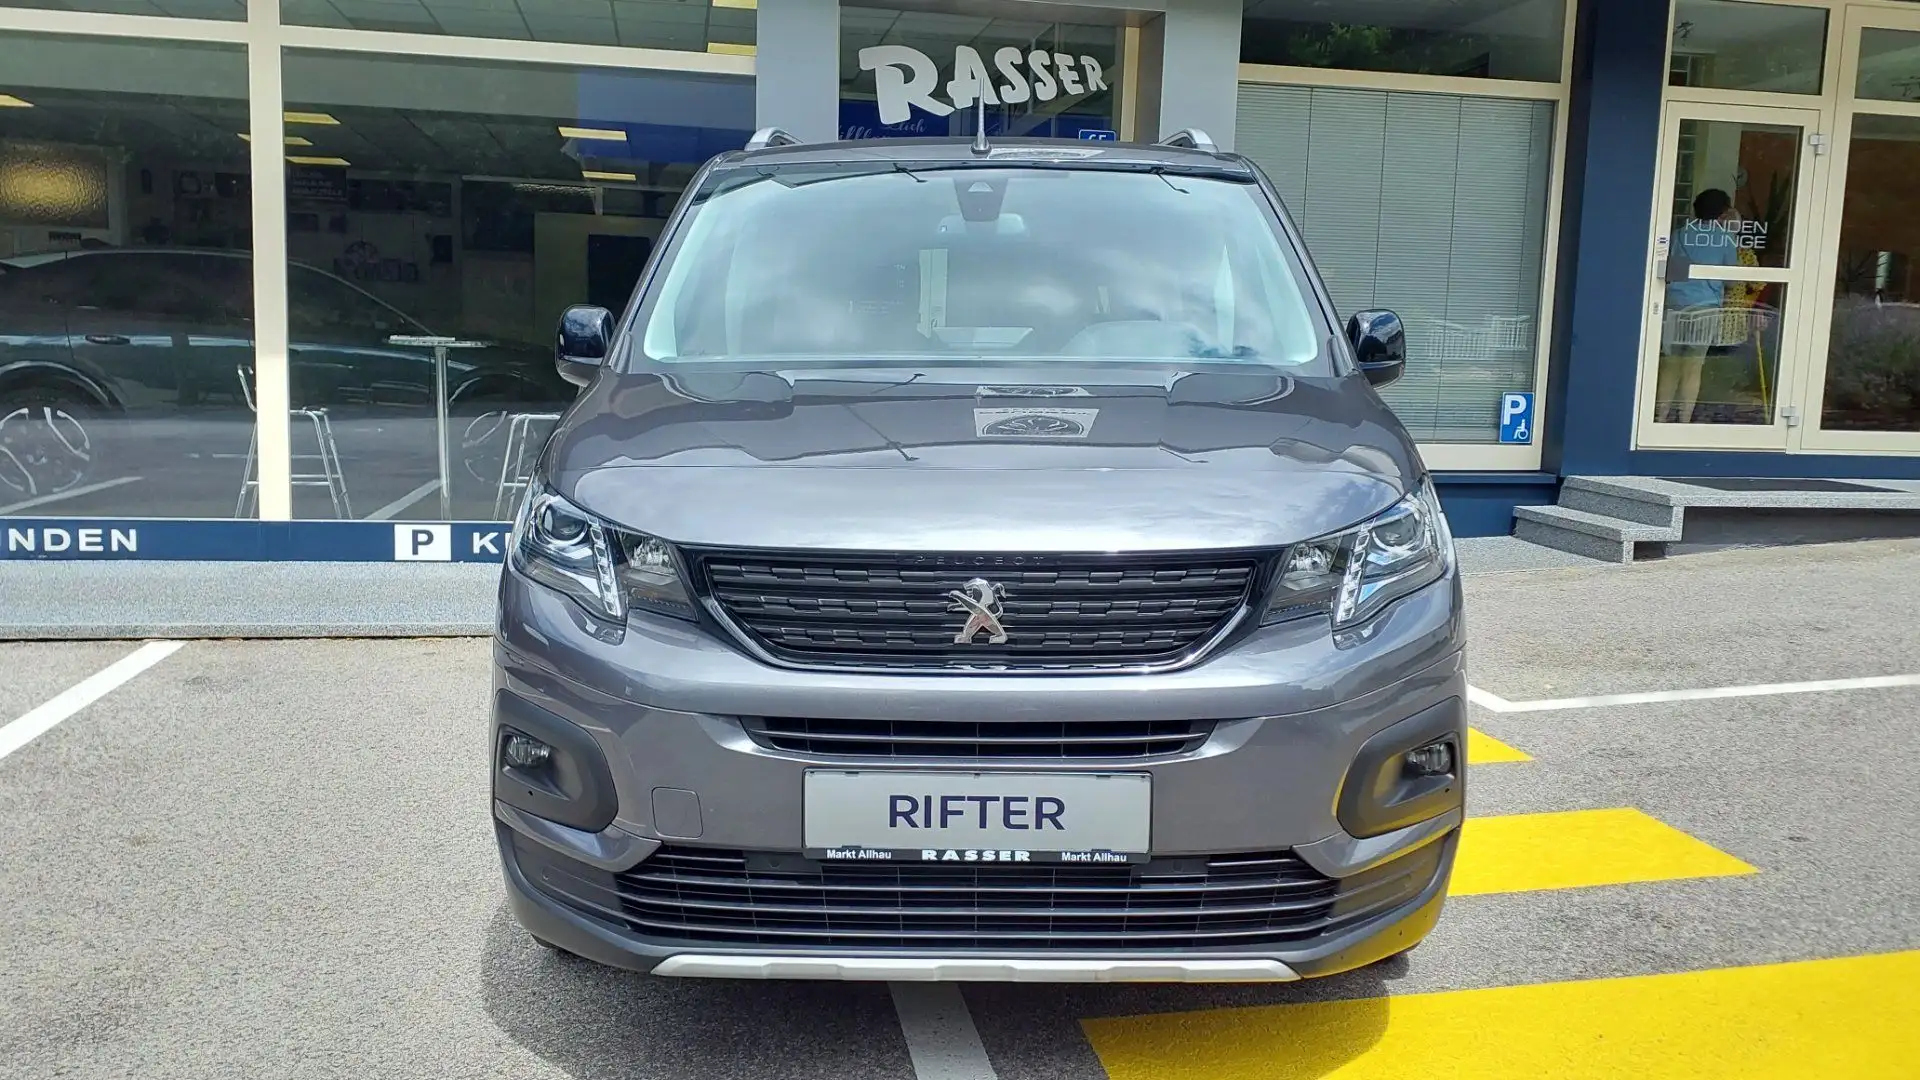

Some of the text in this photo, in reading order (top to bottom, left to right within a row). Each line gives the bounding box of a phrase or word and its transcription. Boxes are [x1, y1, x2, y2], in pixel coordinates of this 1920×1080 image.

[858, 45, 1108, 125] RASSER
[1685, 218, 1768, 234] KUNDEN
[1684, 233, 1767, 249] LOUNGE
[1503, 394, 1527, 425] P
[0, 528, 137, 552] NDEN
[411, 529, 511, 556] P K
[889, 795, 1065, 830] RIFTER
[826, 849, 892, 859] Markt Allhau
[921, 849, 1031, 862] RASSER
[1061, 851, 1128, 862] Markt Allhau
